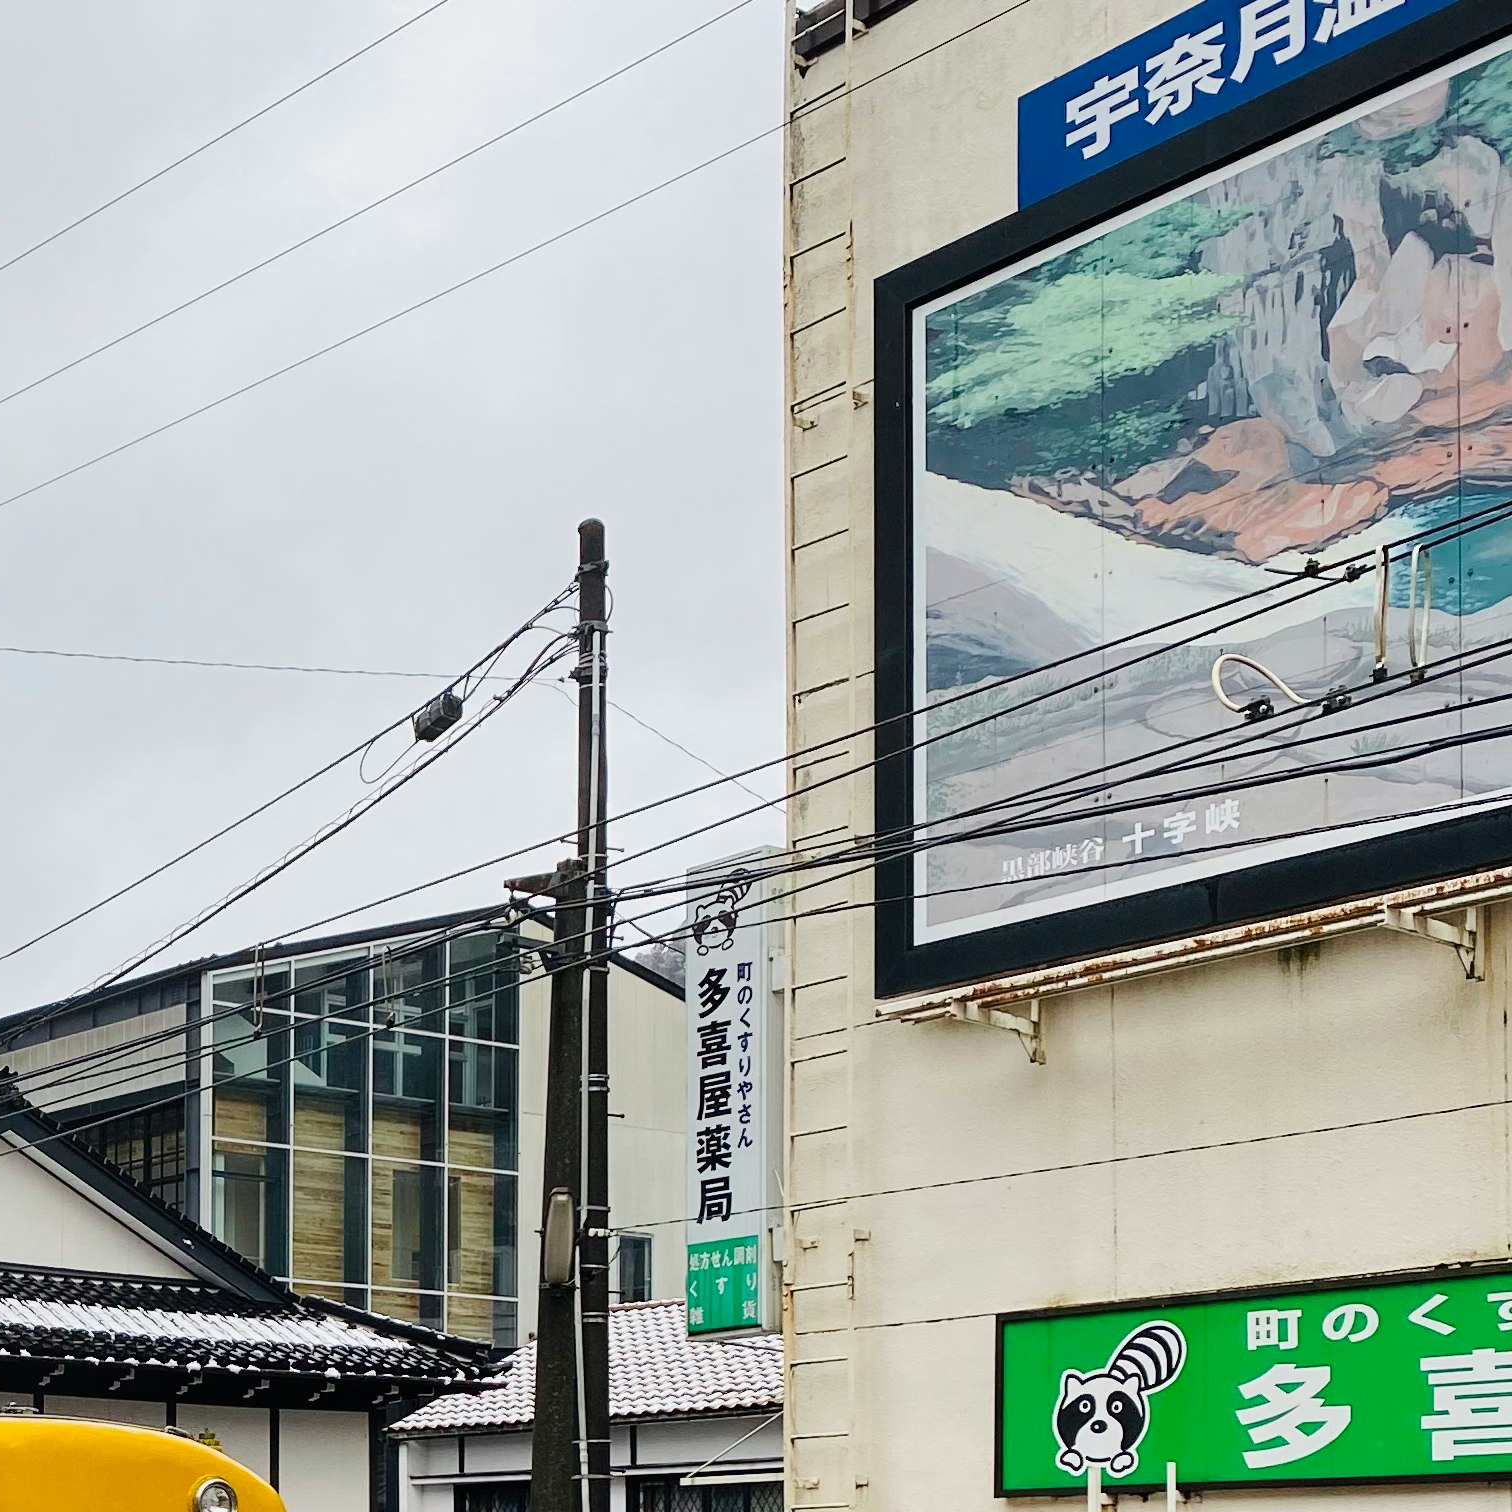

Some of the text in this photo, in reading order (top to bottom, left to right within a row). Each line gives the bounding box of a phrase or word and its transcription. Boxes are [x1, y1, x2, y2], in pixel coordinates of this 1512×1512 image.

[1065, 0, 1406, 160] 宇奈月
[1122, 799, 1241, 854] 十字峡
[696, 967, 732, 1225] 多喜屋薬局
[736, 961, 753, 1149] 町のくすりやさん
[689, 1272, 757, 1297] くすり
